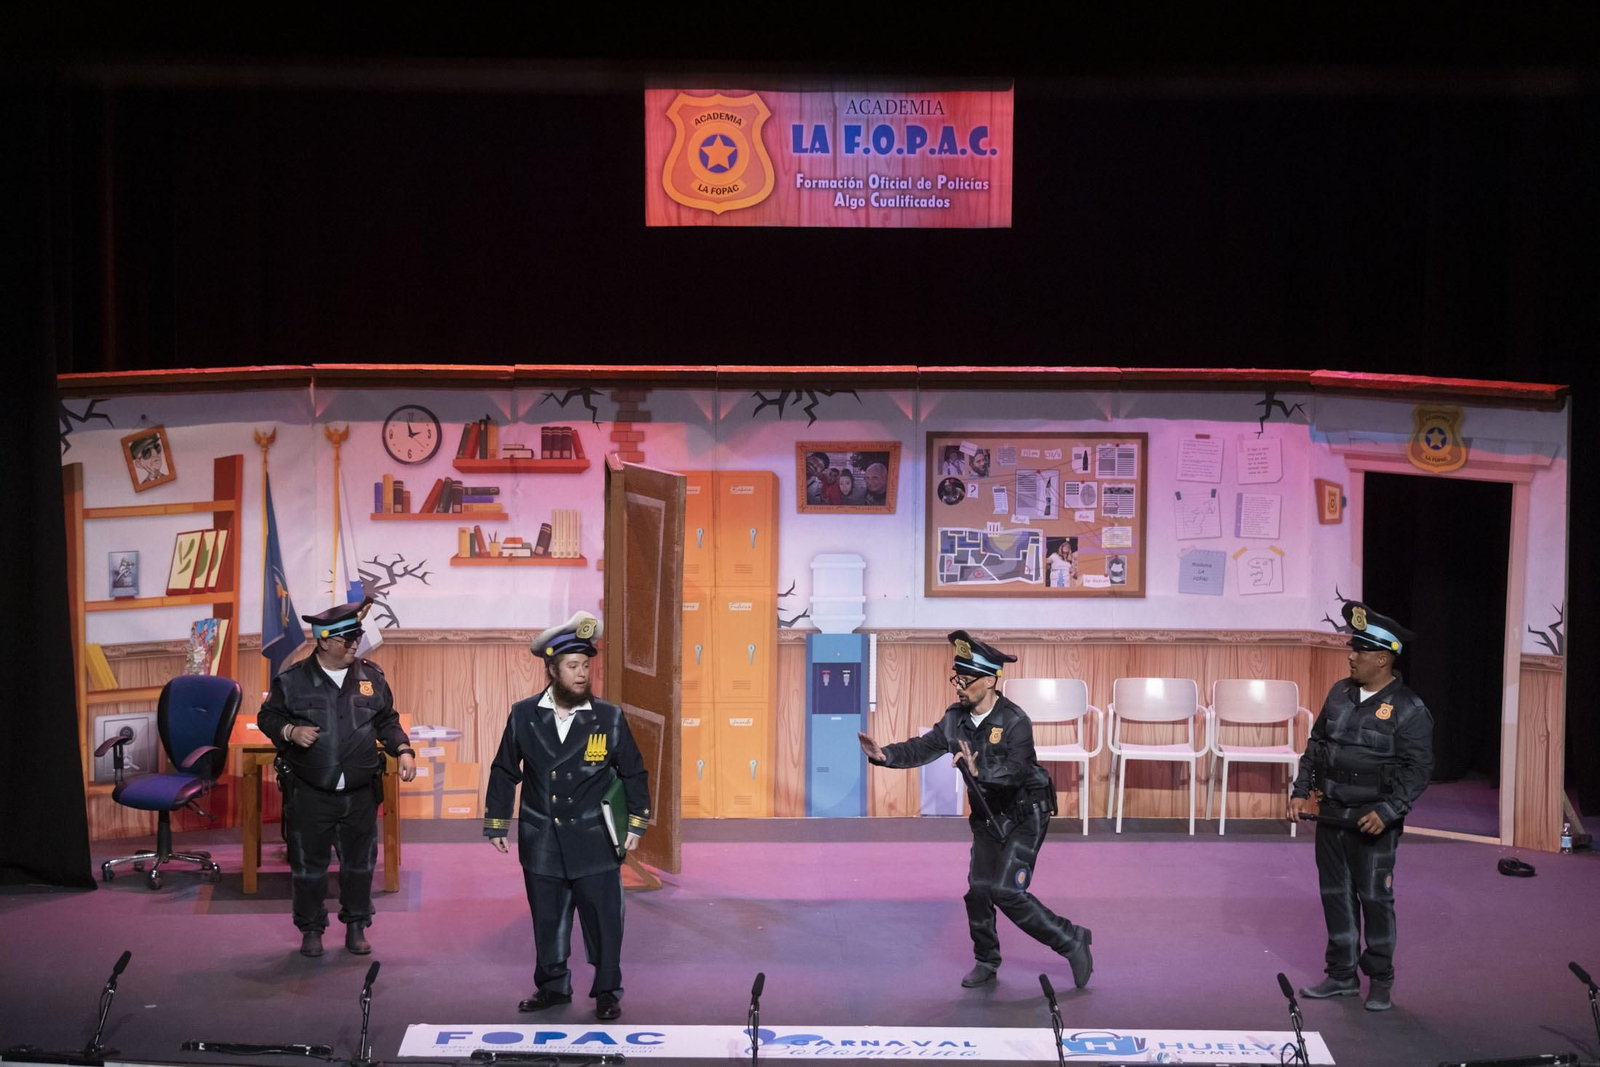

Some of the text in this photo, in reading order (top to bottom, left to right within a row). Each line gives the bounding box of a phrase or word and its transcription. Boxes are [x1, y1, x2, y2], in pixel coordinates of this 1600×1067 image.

[845, 99, 945, 115] ACADEMIA
[694, 112, 742, 126] ACADEMIA
[791, 124, 998, 156] LA F.O.P.A.C.
[795, 173, 989, 190] Formación Oficial de Policías
[698, 183, 739, 195] LA FOPAC
[834, 192, 950, 210] Algo Cualificados
[407, 449, 412, 459] 6
[434, 1031, 665, 1045] FOPAC
[790, 1040, 977, 1048] CARNAVAL
